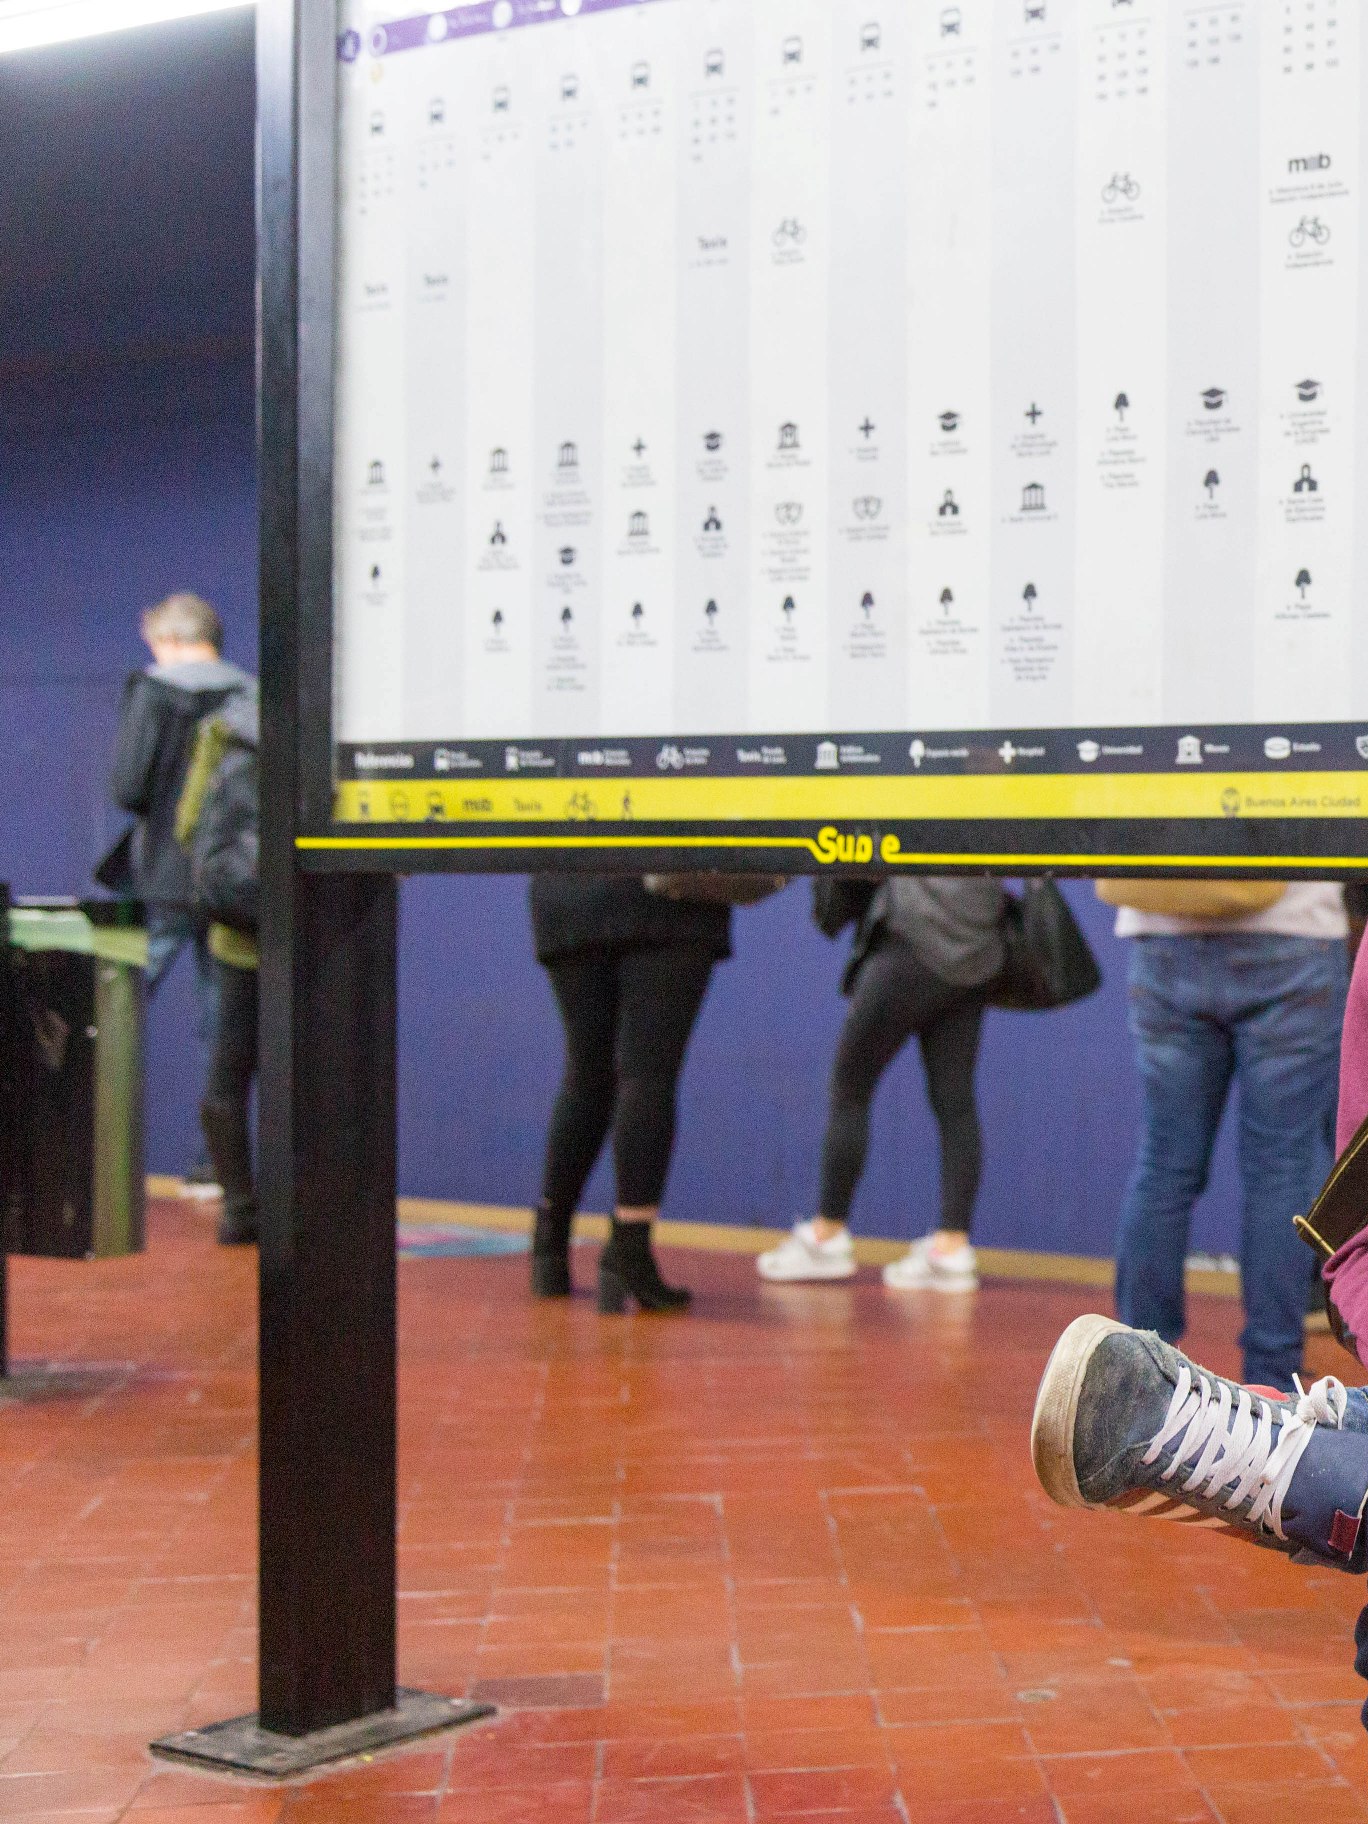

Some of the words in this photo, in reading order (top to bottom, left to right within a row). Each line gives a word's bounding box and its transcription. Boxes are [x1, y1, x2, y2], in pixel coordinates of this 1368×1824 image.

[1246, 796, 1286, 809] Buenos
[1290, 795, 1318, 808] Aires
[1320, 795, 1361, 808] Ciudad
